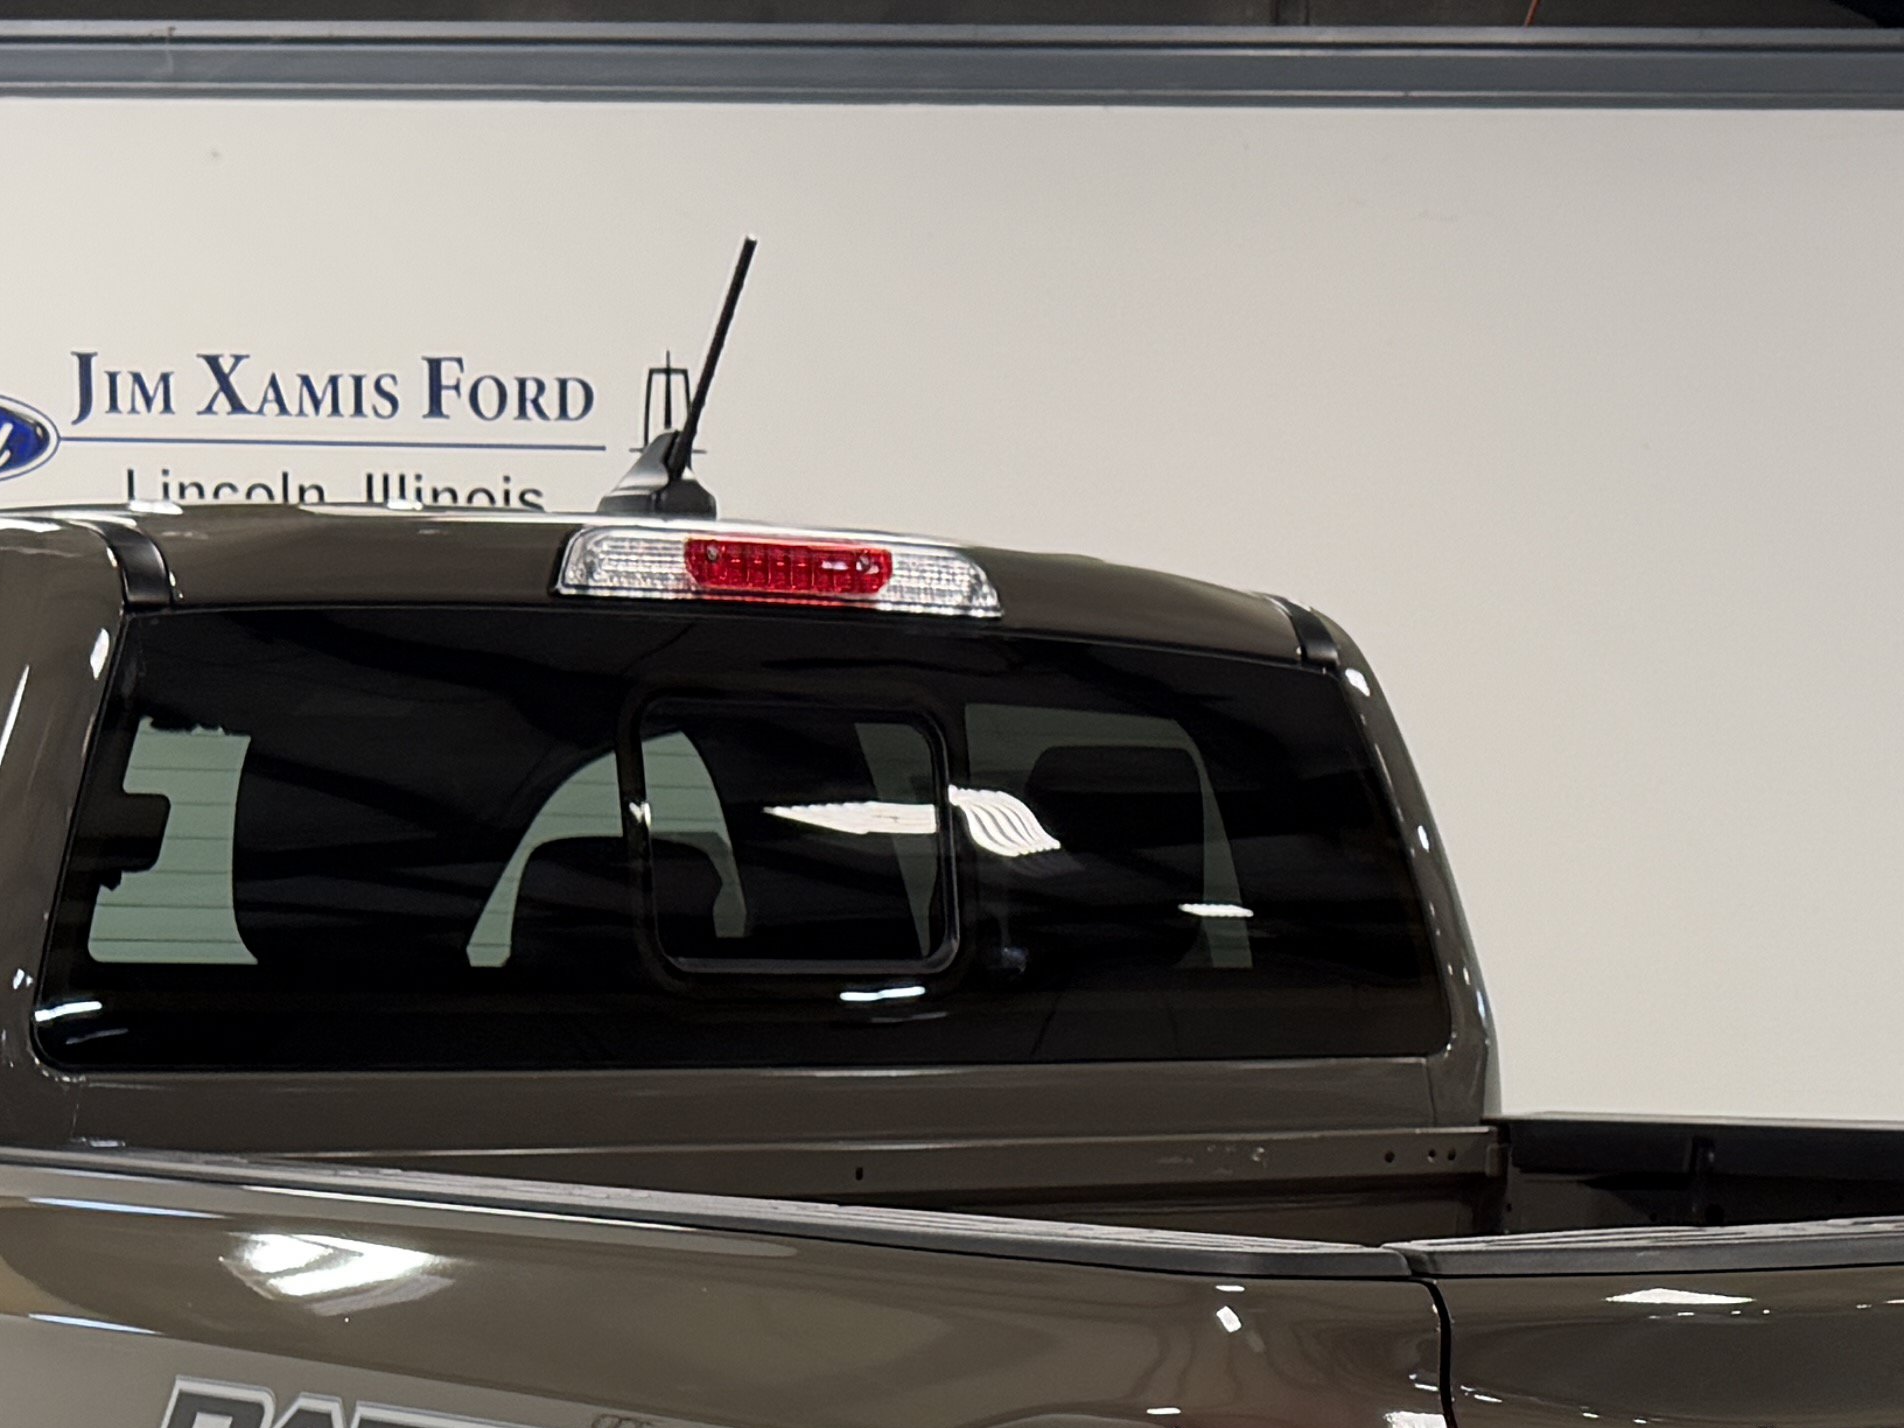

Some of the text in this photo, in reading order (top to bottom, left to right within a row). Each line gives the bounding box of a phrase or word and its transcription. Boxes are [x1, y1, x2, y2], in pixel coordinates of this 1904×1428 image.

[70, 350, 594, 428] JIM XAMIS FORD
[127, 469, 326, 501] Lincoln
